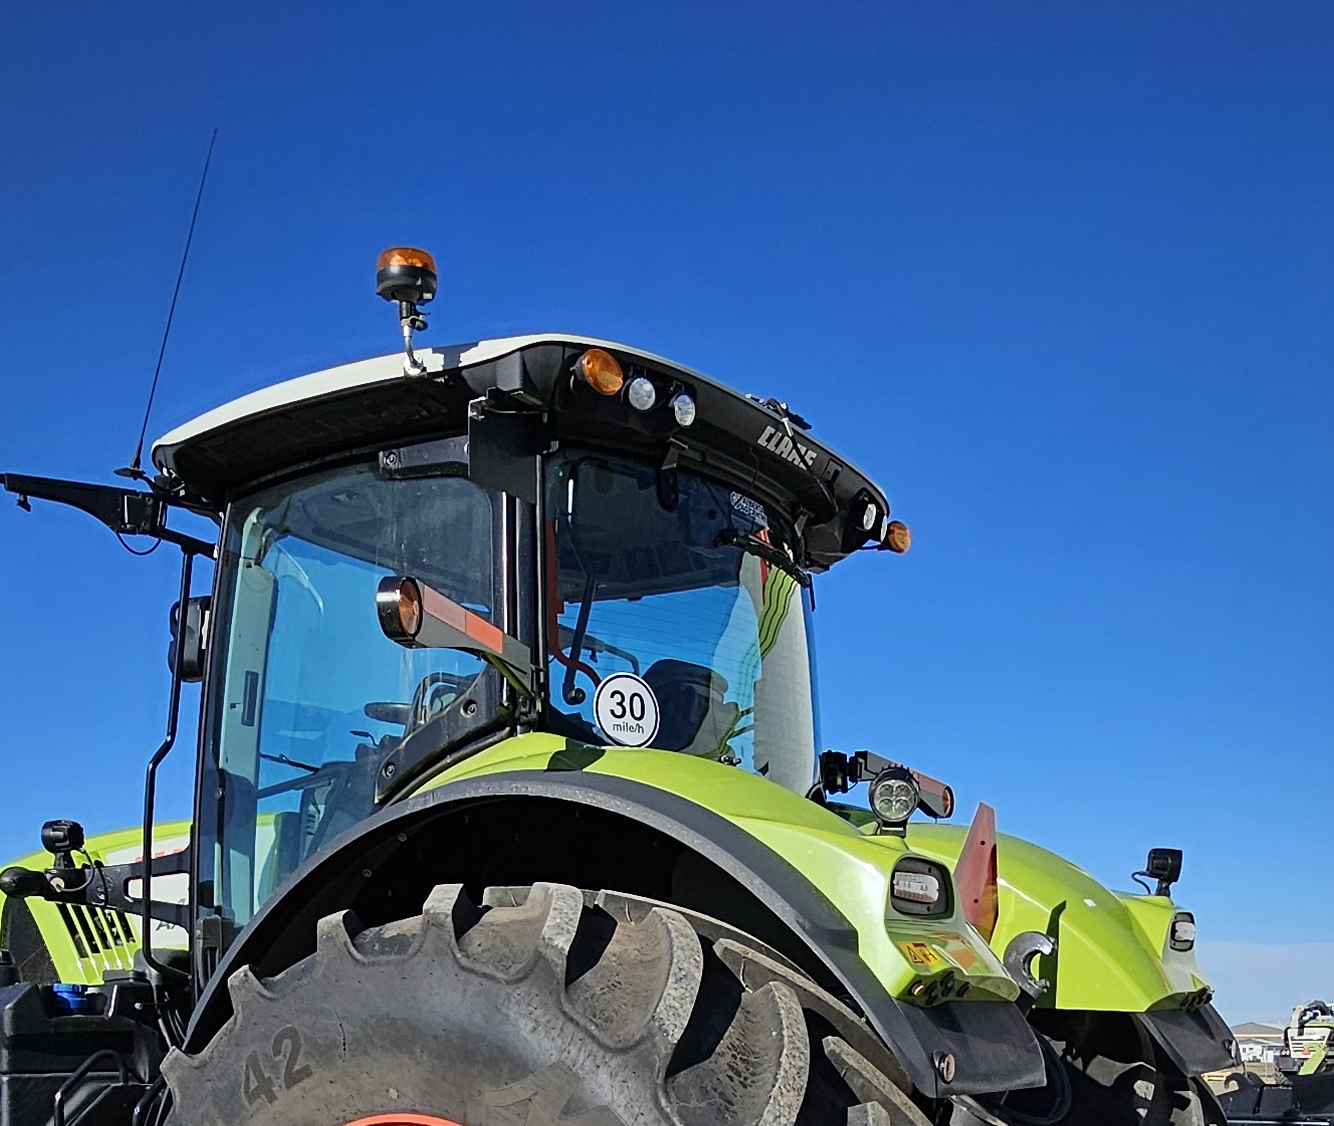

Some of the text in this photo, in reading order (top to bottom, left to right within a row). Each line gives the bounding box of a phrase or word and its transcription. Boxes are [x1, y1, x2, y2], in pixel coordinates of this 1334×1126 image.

[610, 690, 646, 721] 30
[612, 721, 645, 734] mile/h
[243, 1025, 314, 1105] 42
